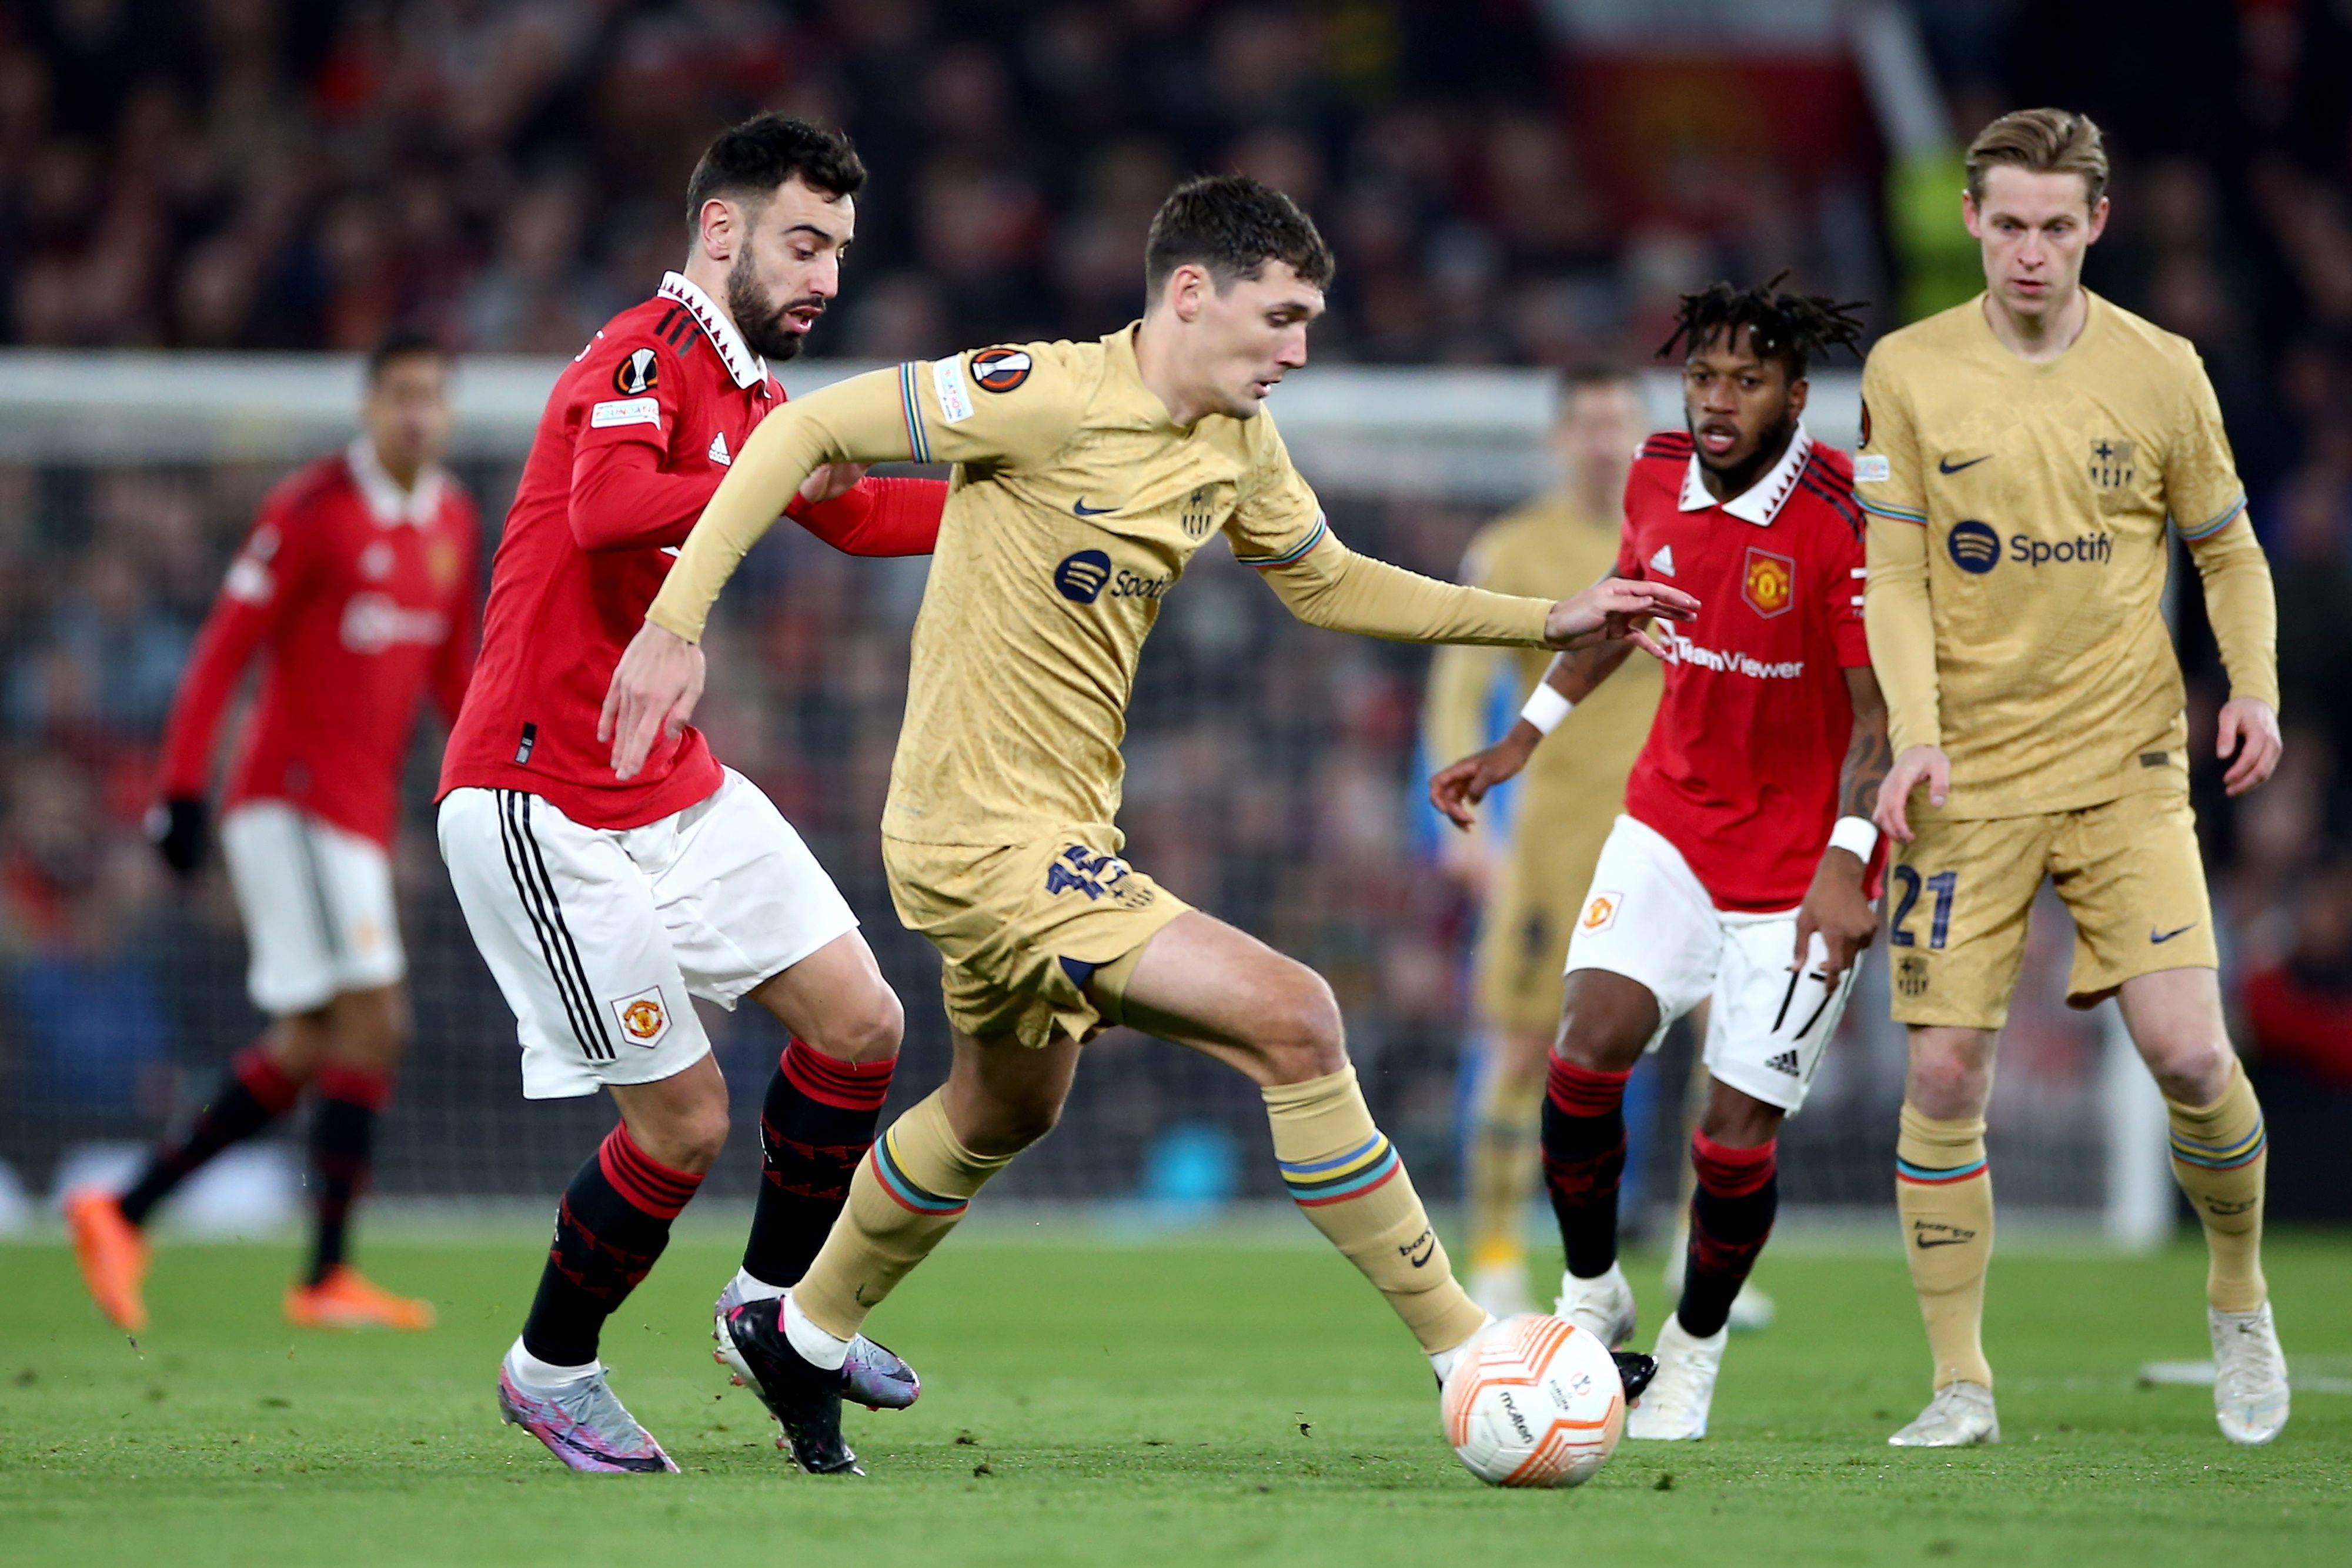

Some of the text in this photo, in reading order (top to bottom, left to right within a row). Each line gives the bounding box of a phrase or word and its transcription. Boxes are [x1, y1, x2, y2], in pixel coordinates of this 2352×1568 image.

[2010, 532, 2114, 567] Spotify
[1111, 570, 1165, 598] Spot
[1891, 865, 1958, 950] 21
[1770, 966, 1837, 1041] 17
[1499, 1391, 1534, 1443] molten
